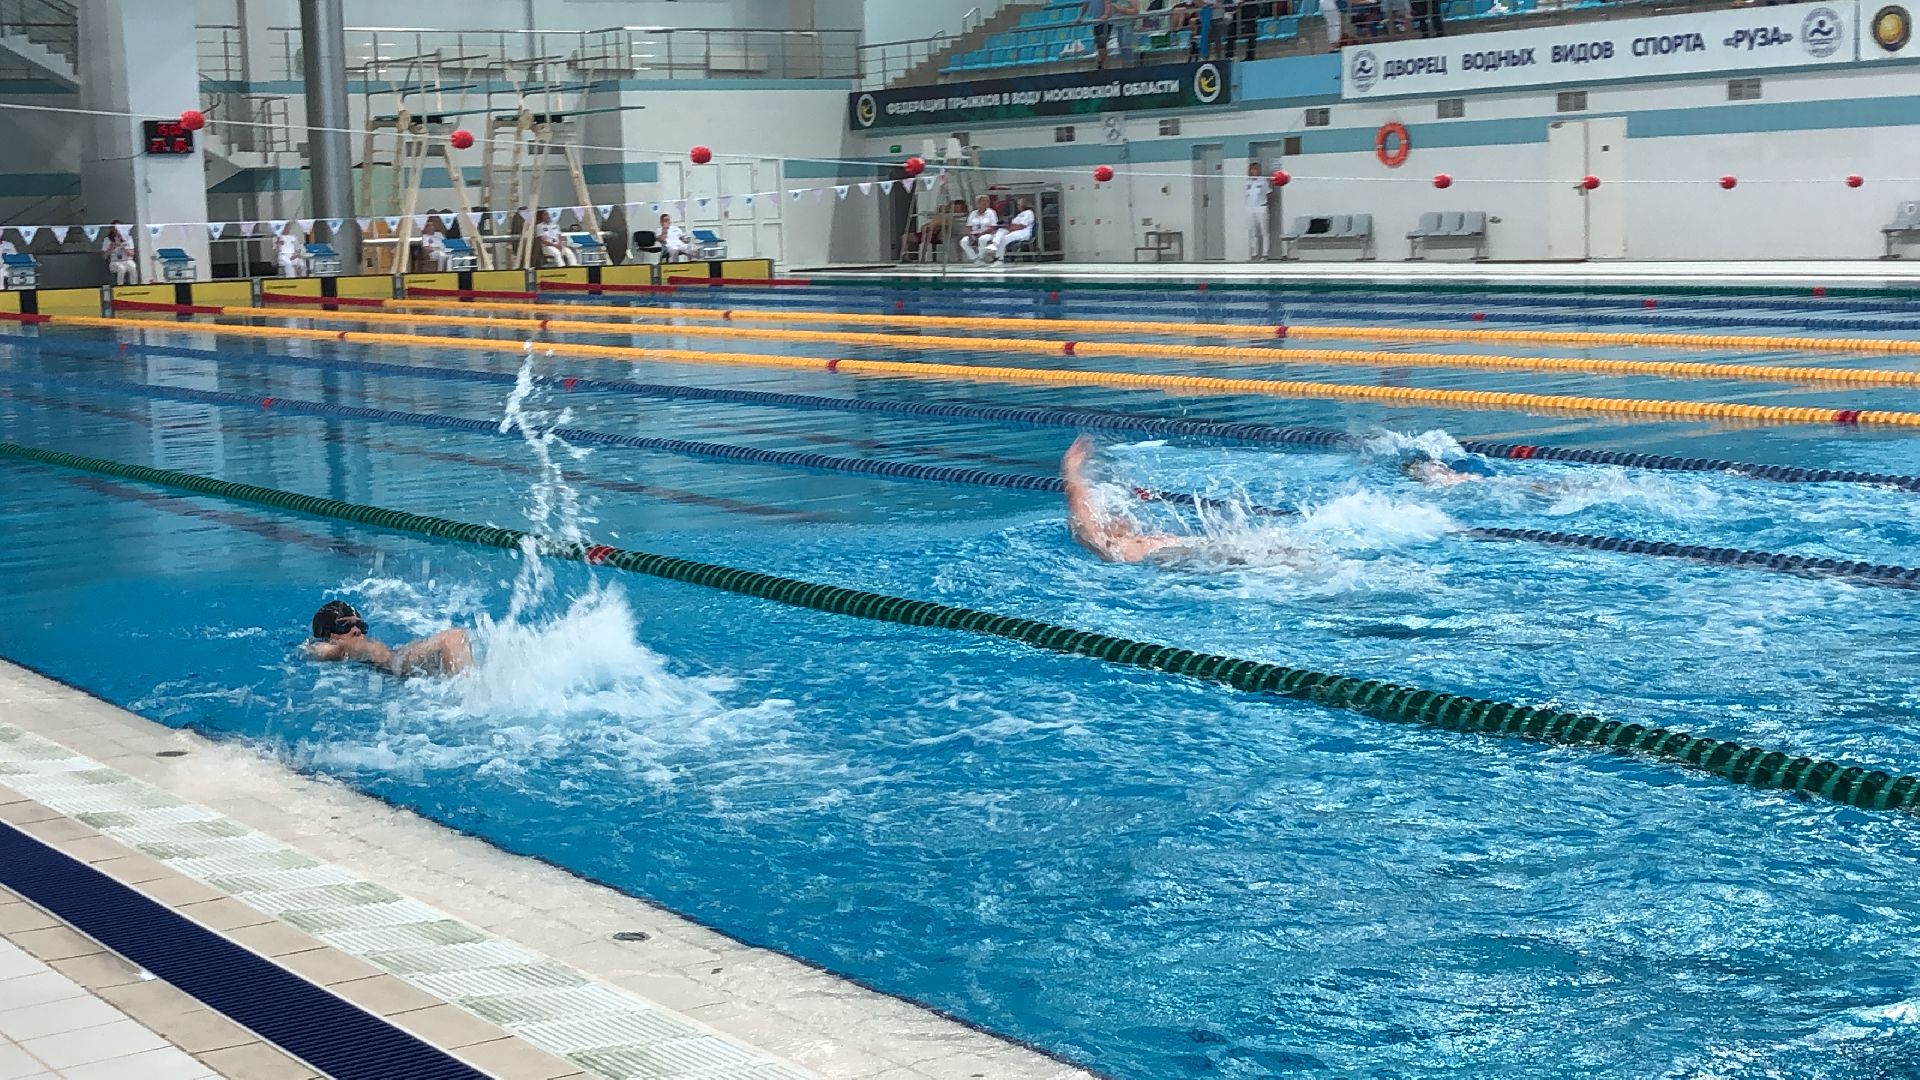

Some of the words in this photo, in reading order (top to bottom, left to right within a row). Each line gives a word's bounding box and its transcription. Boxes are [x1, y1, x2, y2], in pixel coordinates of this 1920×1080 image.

[1383, 56, 1447, 80] ДВОРЕЦ
[1462, 48, 1536, 71] ВОДНЫХ
[1551, 41, 1615, 63] ВИДОВ
[1632, 32, 1706, 57] СПОРТА
[1723, 26, 1794, 51] «РУЗА»
[1002, 93, 1010, 106] В
[1012, 90, 1041, 106] ВОДУ
[1123, 79, 1180, 96] ОБЛАСТИ
